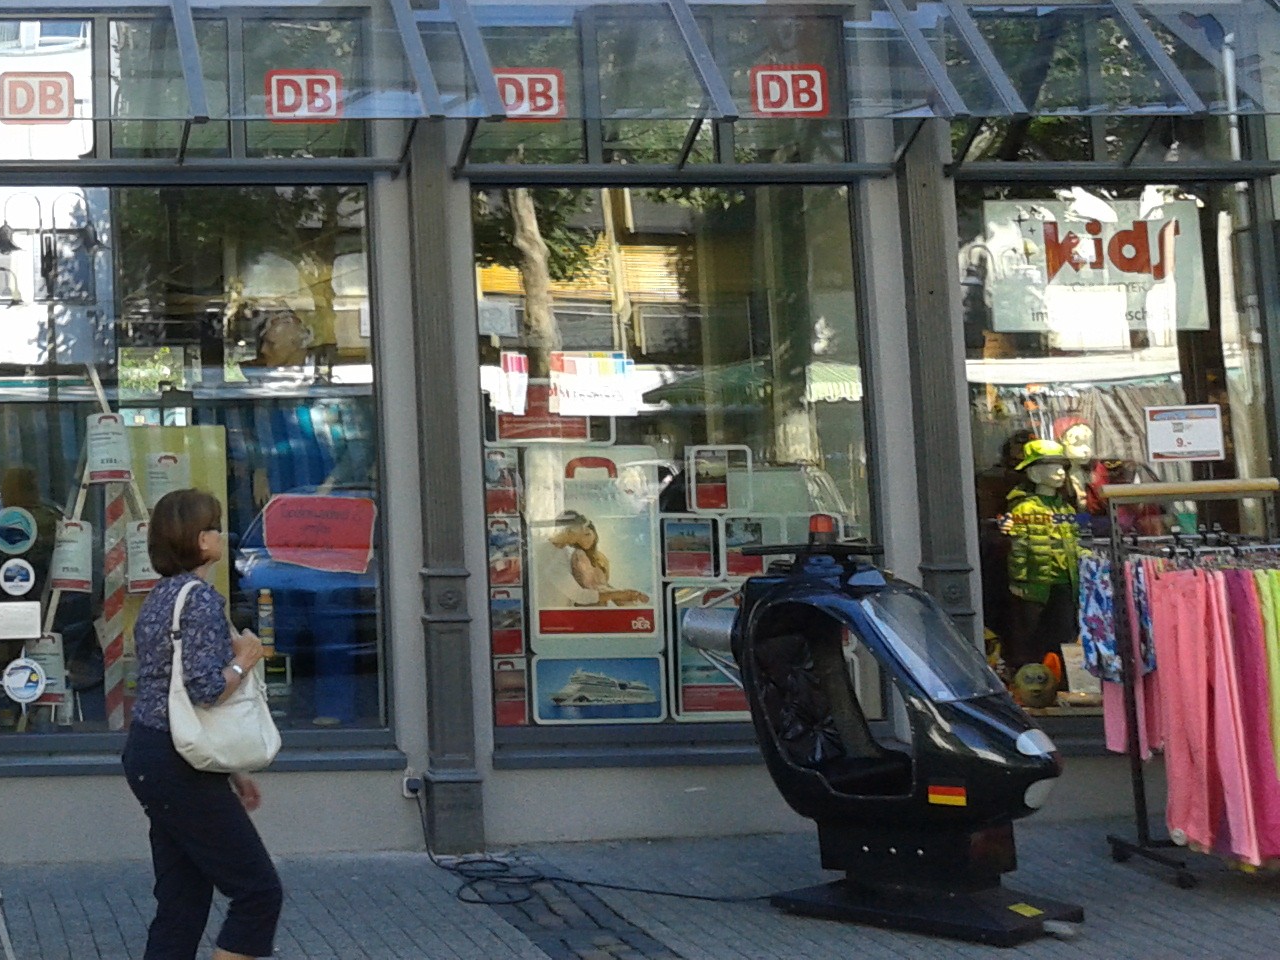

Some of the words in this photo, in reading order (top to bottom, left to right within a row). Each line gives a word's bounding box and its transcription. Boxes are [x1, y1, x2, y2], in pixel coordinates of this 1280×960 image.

[7, 77, 65, 116] DB
[275, 77, 333, 115] DB
[497, 76, 554, 112] DB
[760, 73, 819, 109] DB
[1042, 218, 1181, 283] kids
